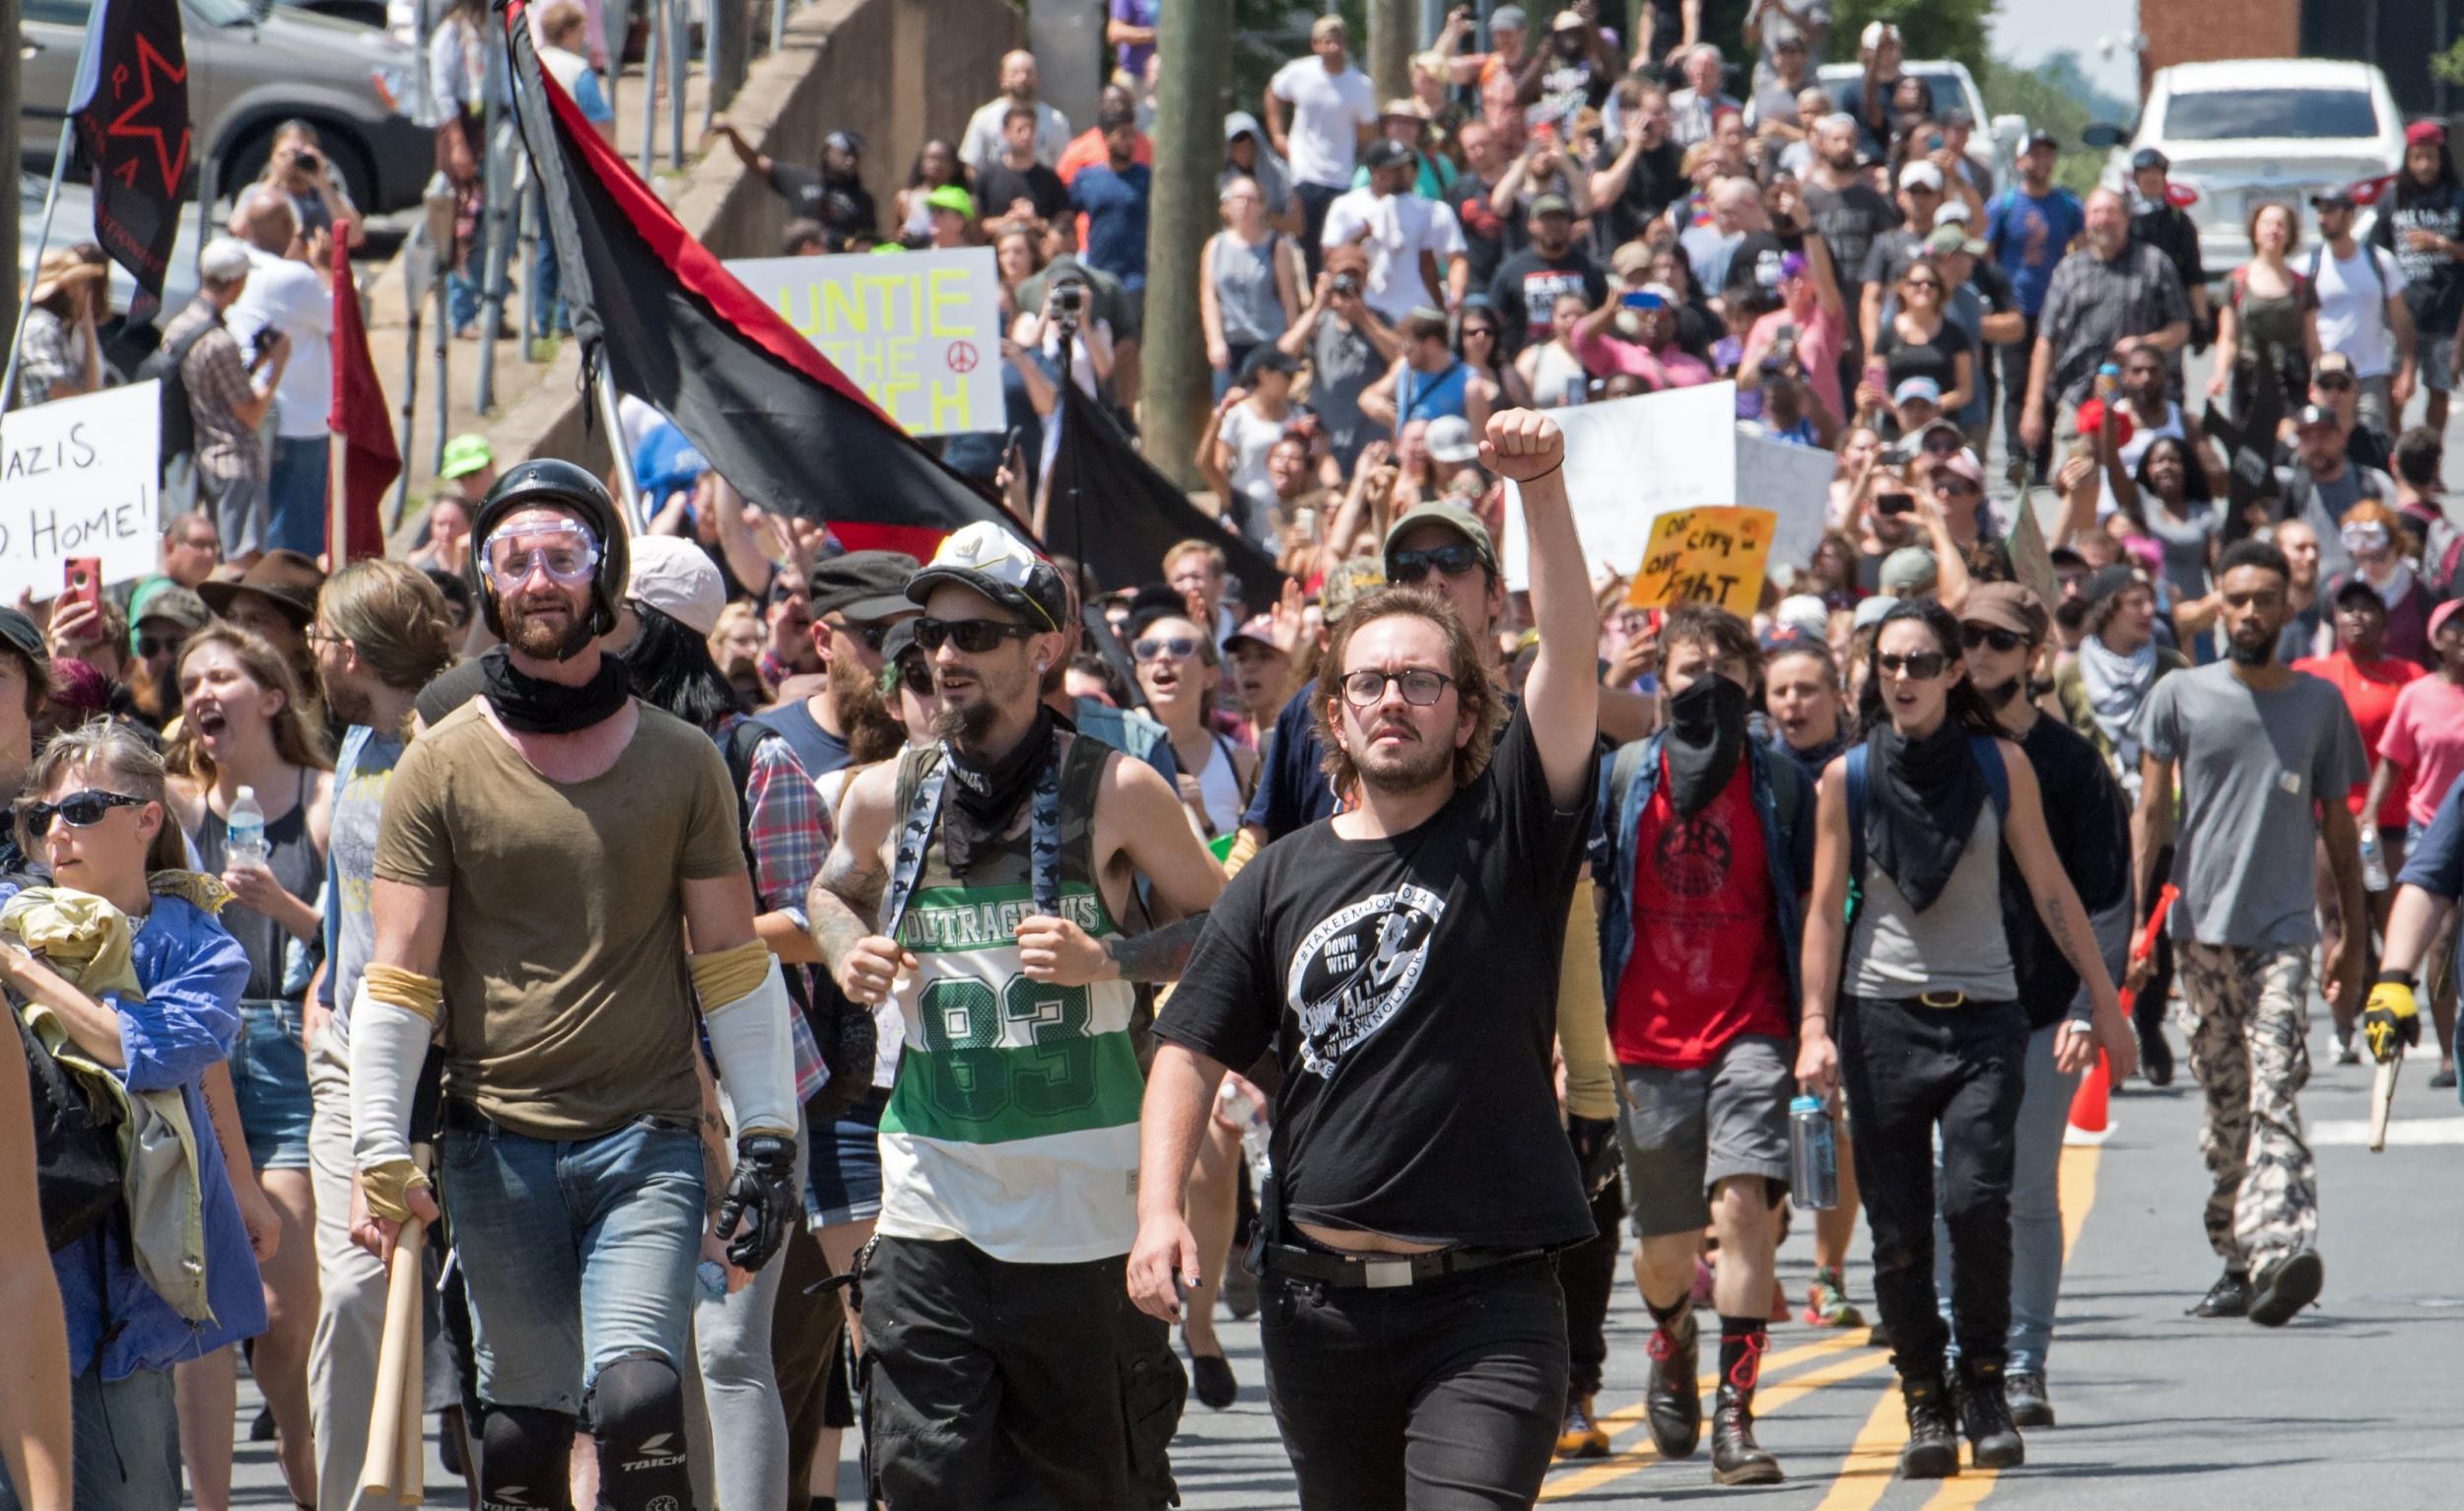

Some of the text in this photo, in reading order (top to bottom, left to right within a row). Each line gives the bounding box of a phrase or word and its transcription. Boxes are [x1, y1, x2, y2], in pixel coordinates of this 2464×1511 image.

[780, 268, 977, 337] UNTIE
[821, 337, 921, 380] THE
[31, 483, 148, 559] HOME!
[904, 893, 1101, 947] OUTRAGUS
[1325, 934, 1358, 957] DOWN
[1327, 952, 1357, 975] WITH
[918, 970, 1098, 1122] 83
[621, 1453, 686, 1472] TAICHI
